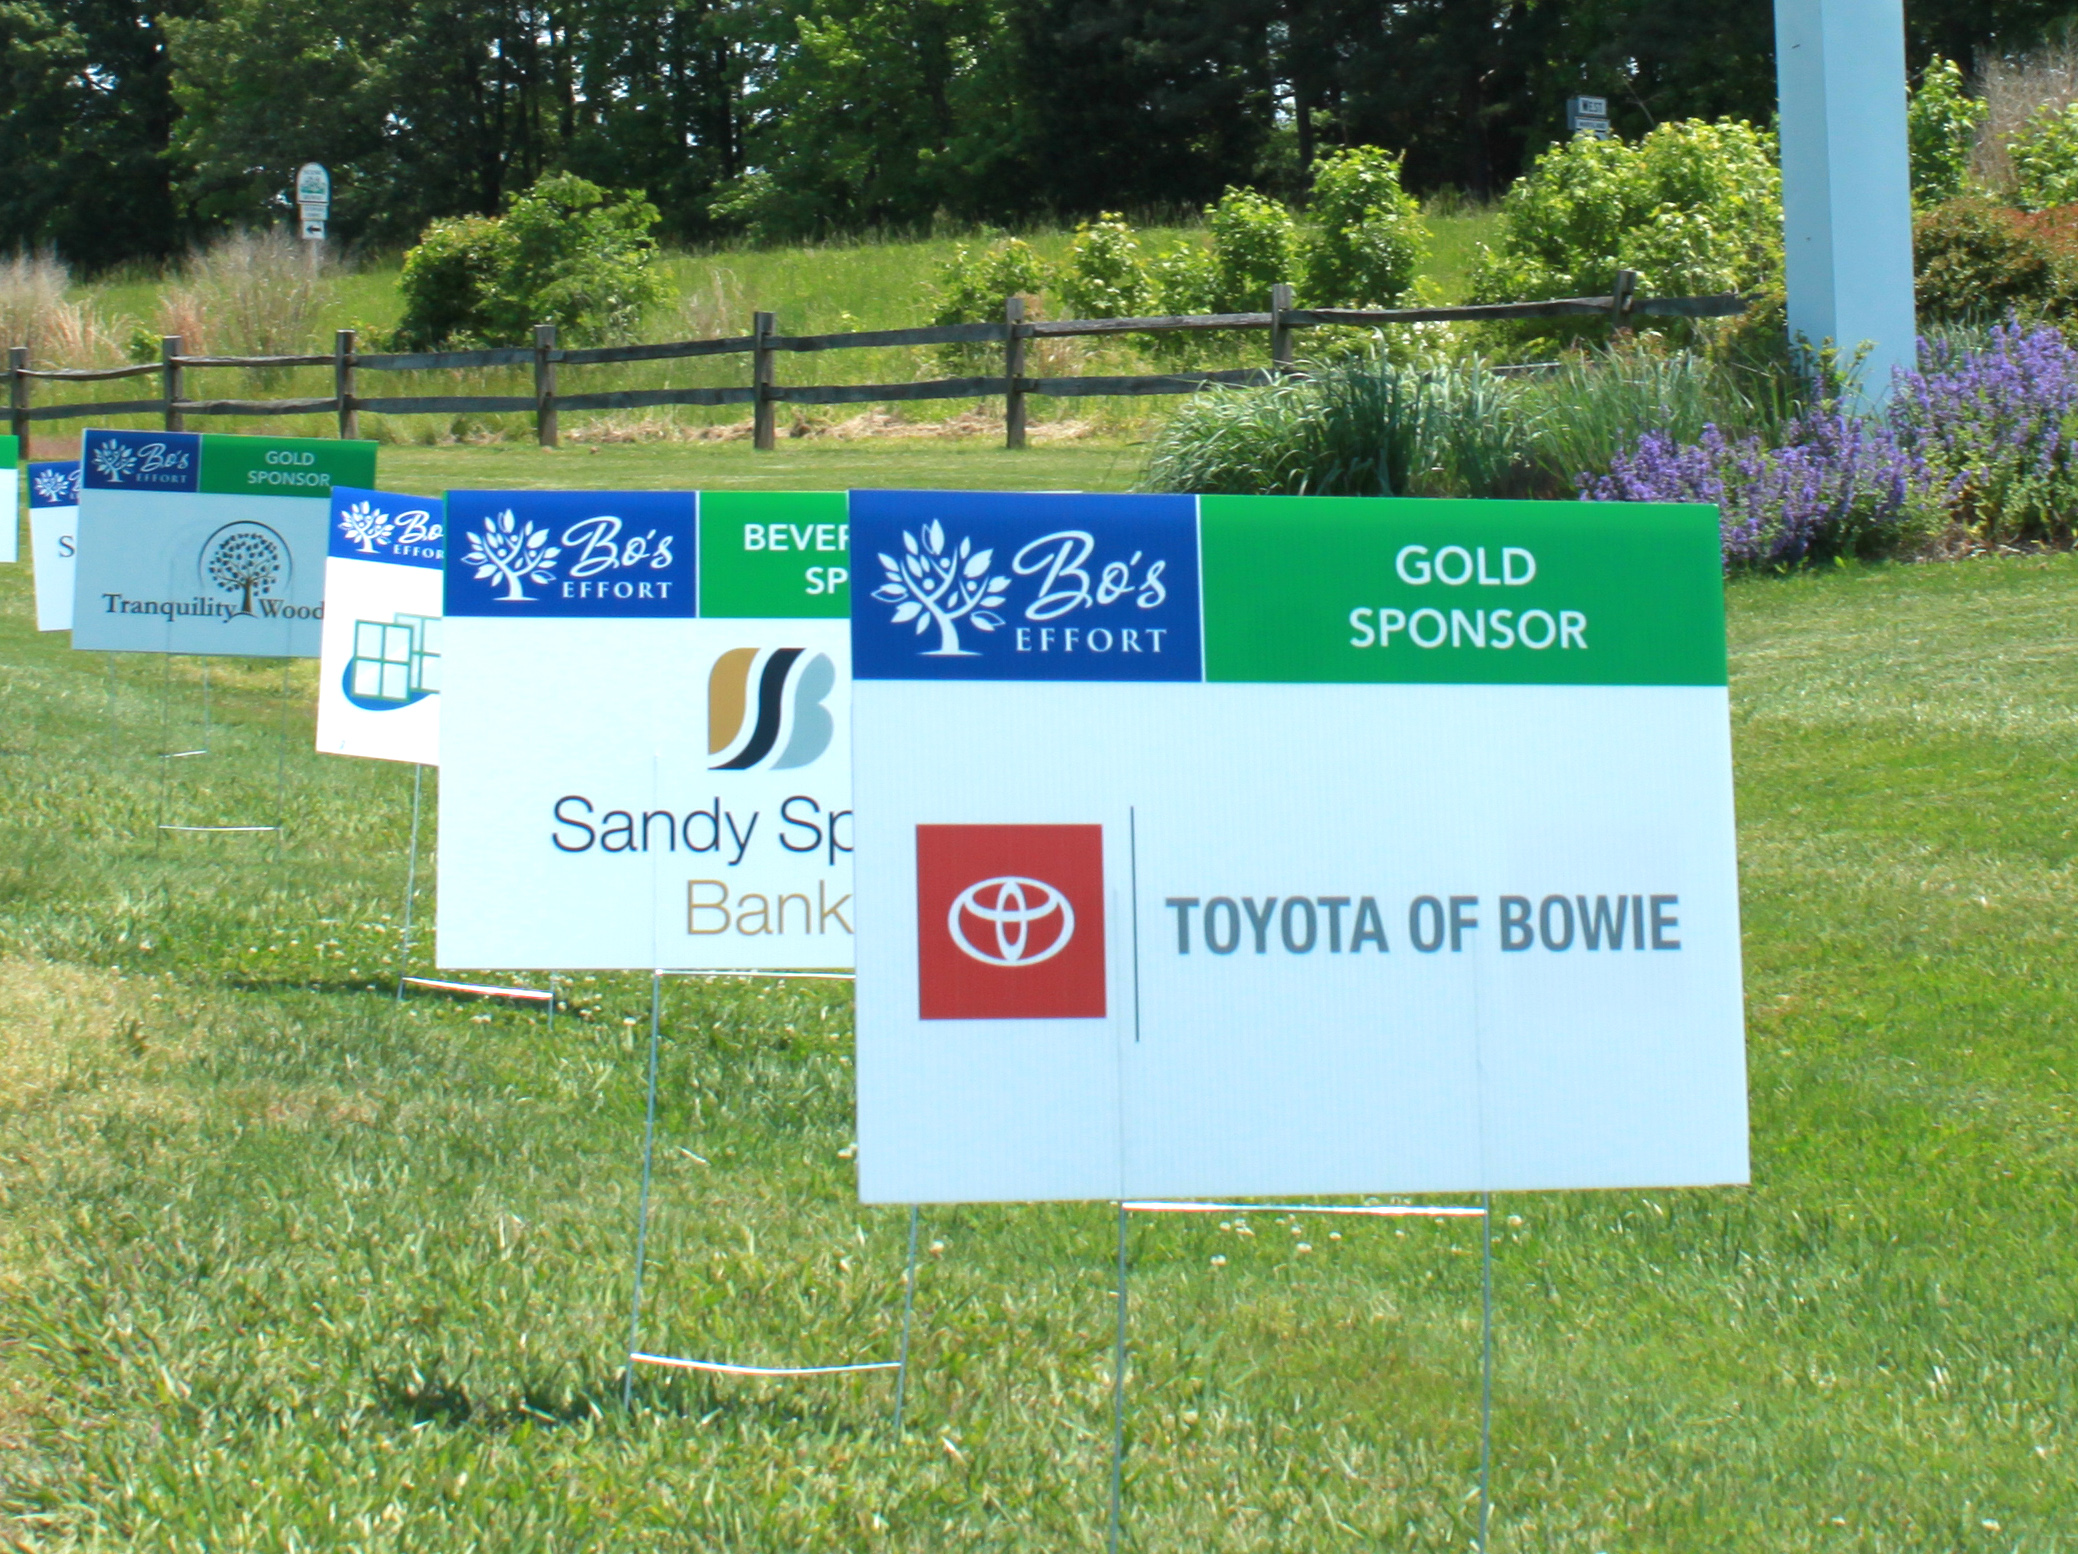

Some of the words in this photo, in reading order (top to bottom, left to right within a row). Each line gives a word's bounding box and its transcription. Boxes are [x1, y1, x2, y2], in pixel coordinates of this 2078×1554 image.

[137, 443, 190, 472] Bo's
[265, 450, 315, 466] GOLD
[136, 474, 188, 484] EFFORT
[248, 470, 330, 487] SPONSOR
[561, 516, 674, 577] Bo's
[805, 566, 849, 595] SP
[1012, 530, 1166, 620] Bo's
[1395, 544, 1537, 586] GOLD
[562, 581, 673, 599] EFFORT
[102, 592, 238, 623] Tranquility
[1015, 628, 1168, 652] EFFORT
[1348, 606, 1588, 649] SPONSOR
[552, 795, 760, 866] Sandy
[686, 879, 854, 936] Bank
[1165, 896, 1390, 955] TOYOTA
[1408, 894, 1480, 953] OF
[1499, 893, 1682, 952] BOWIE
